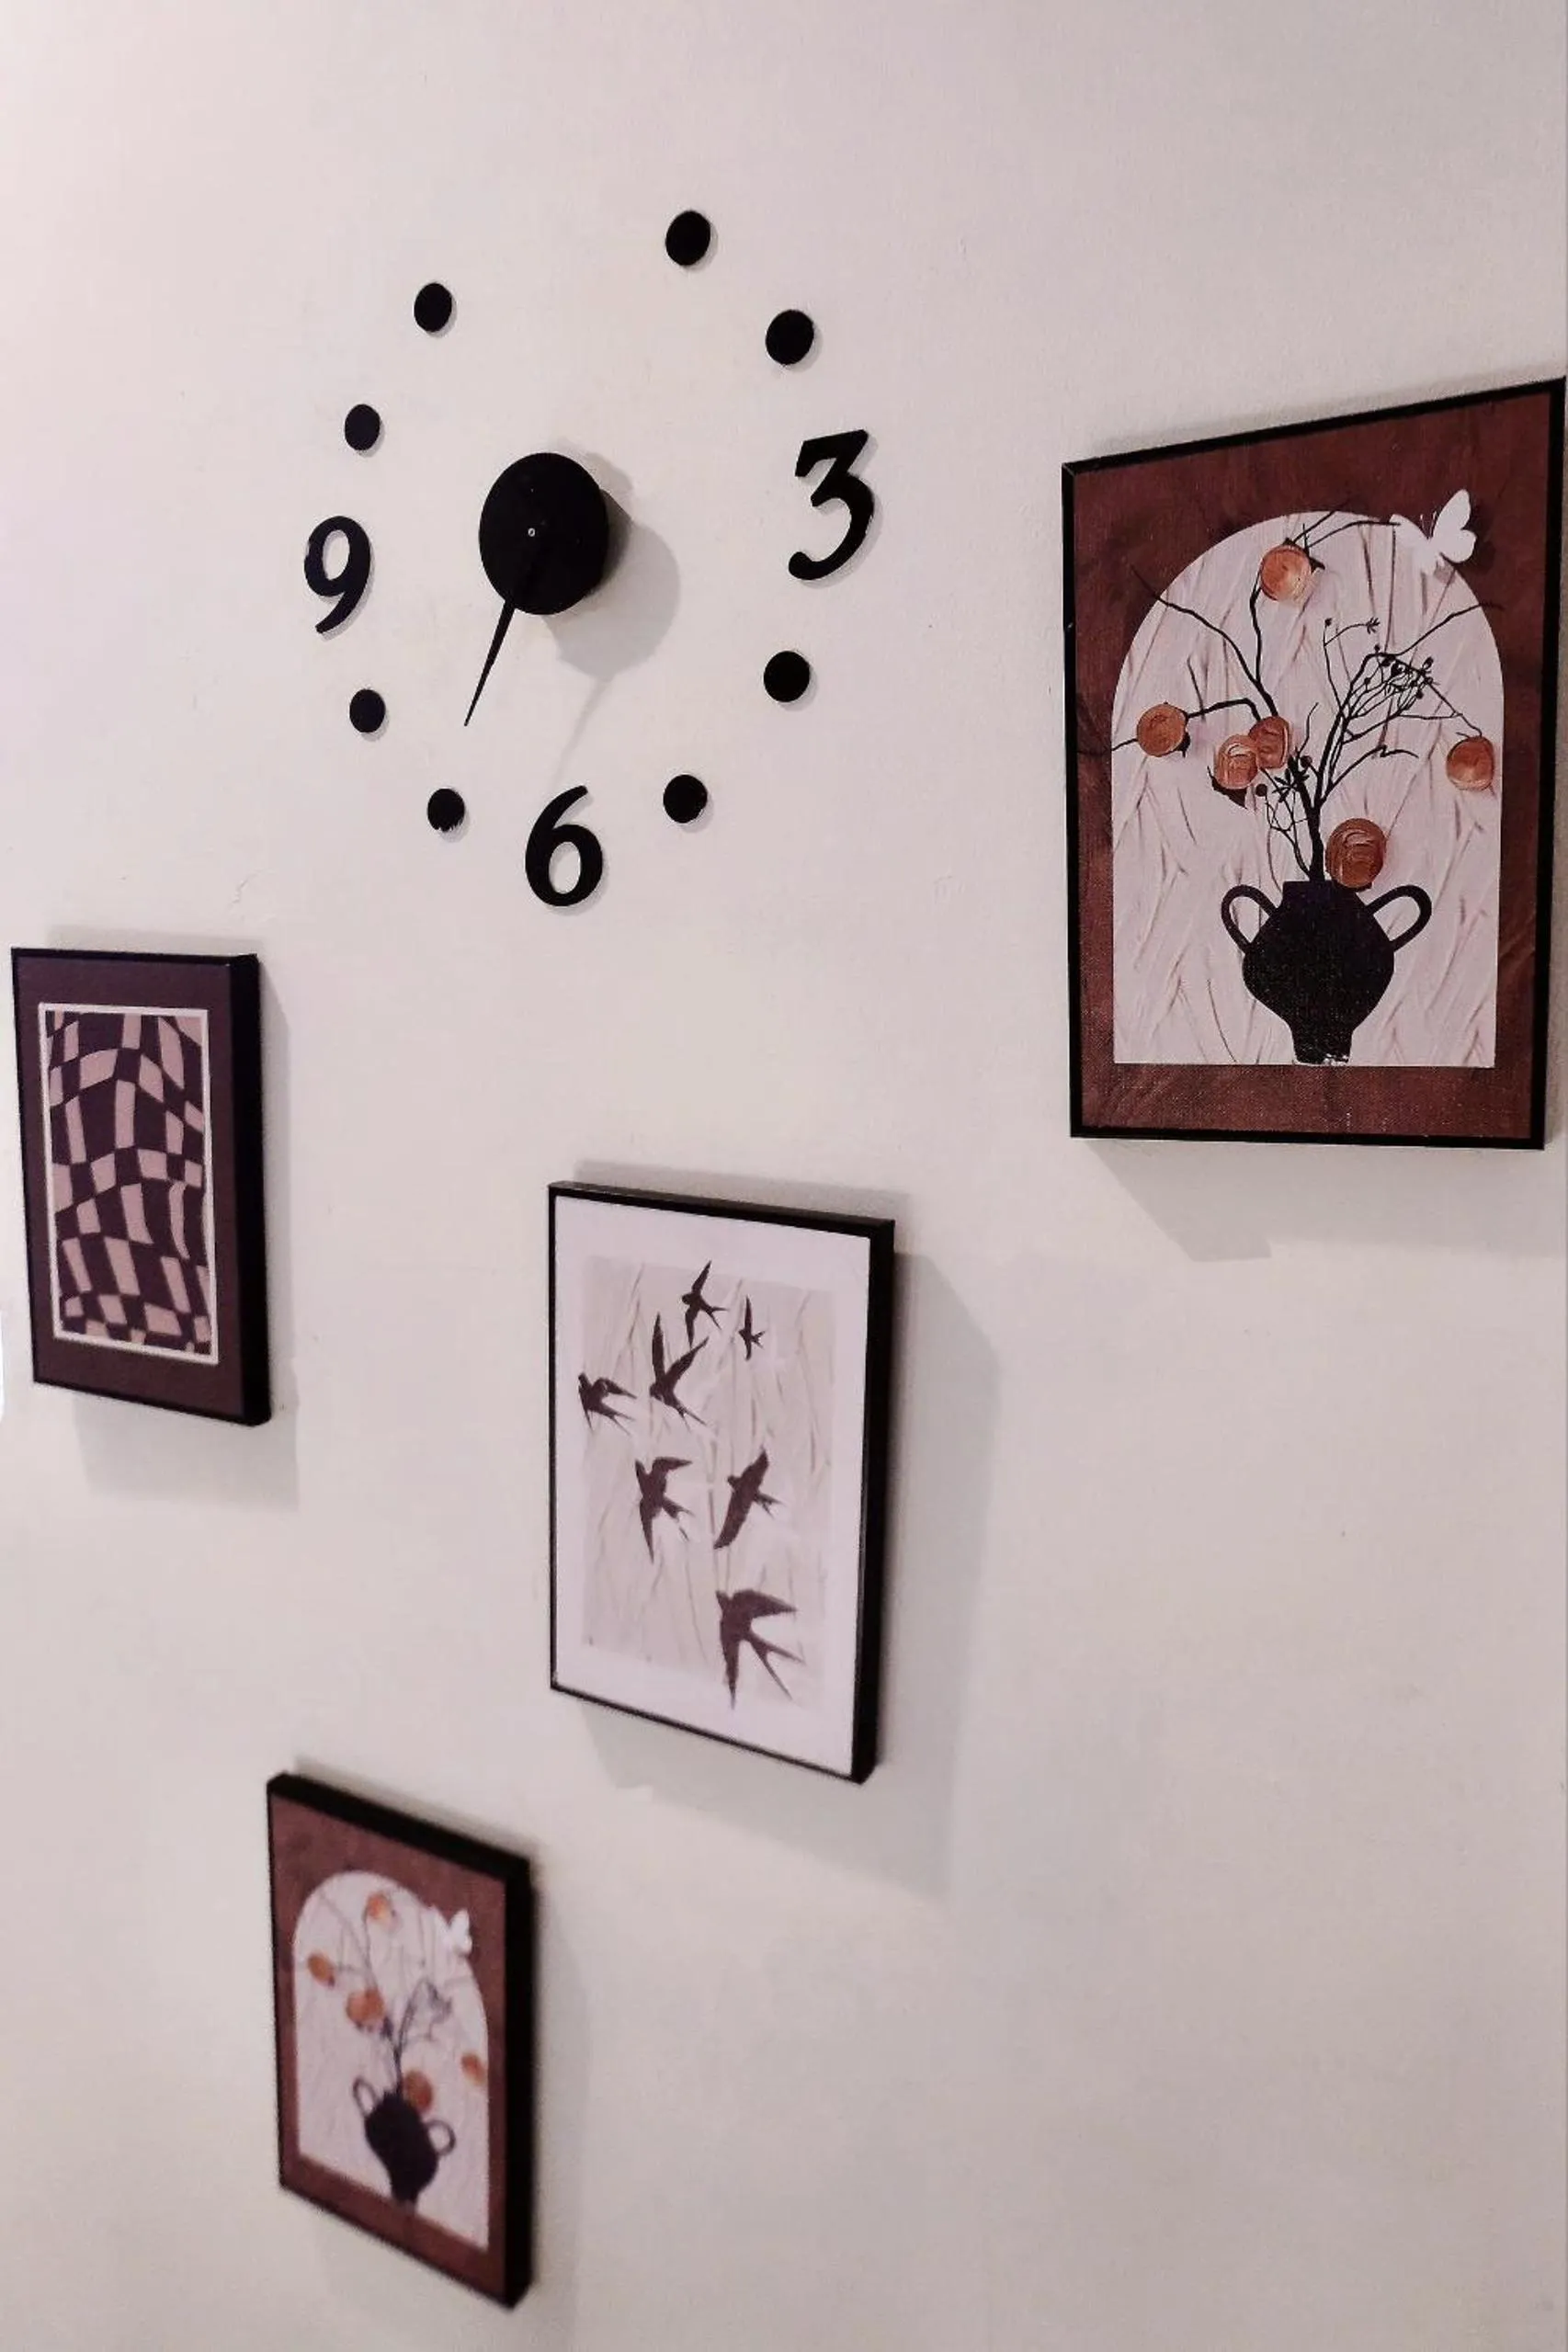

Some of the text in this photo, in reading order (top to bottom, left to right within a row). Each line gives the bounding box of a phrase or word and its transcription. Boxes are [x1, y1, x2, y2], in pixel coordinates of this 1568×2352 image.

[788, 428, 875, 581] 3
[303, 516, 371, 634] 9
[525, 785, 604, 907] 6
